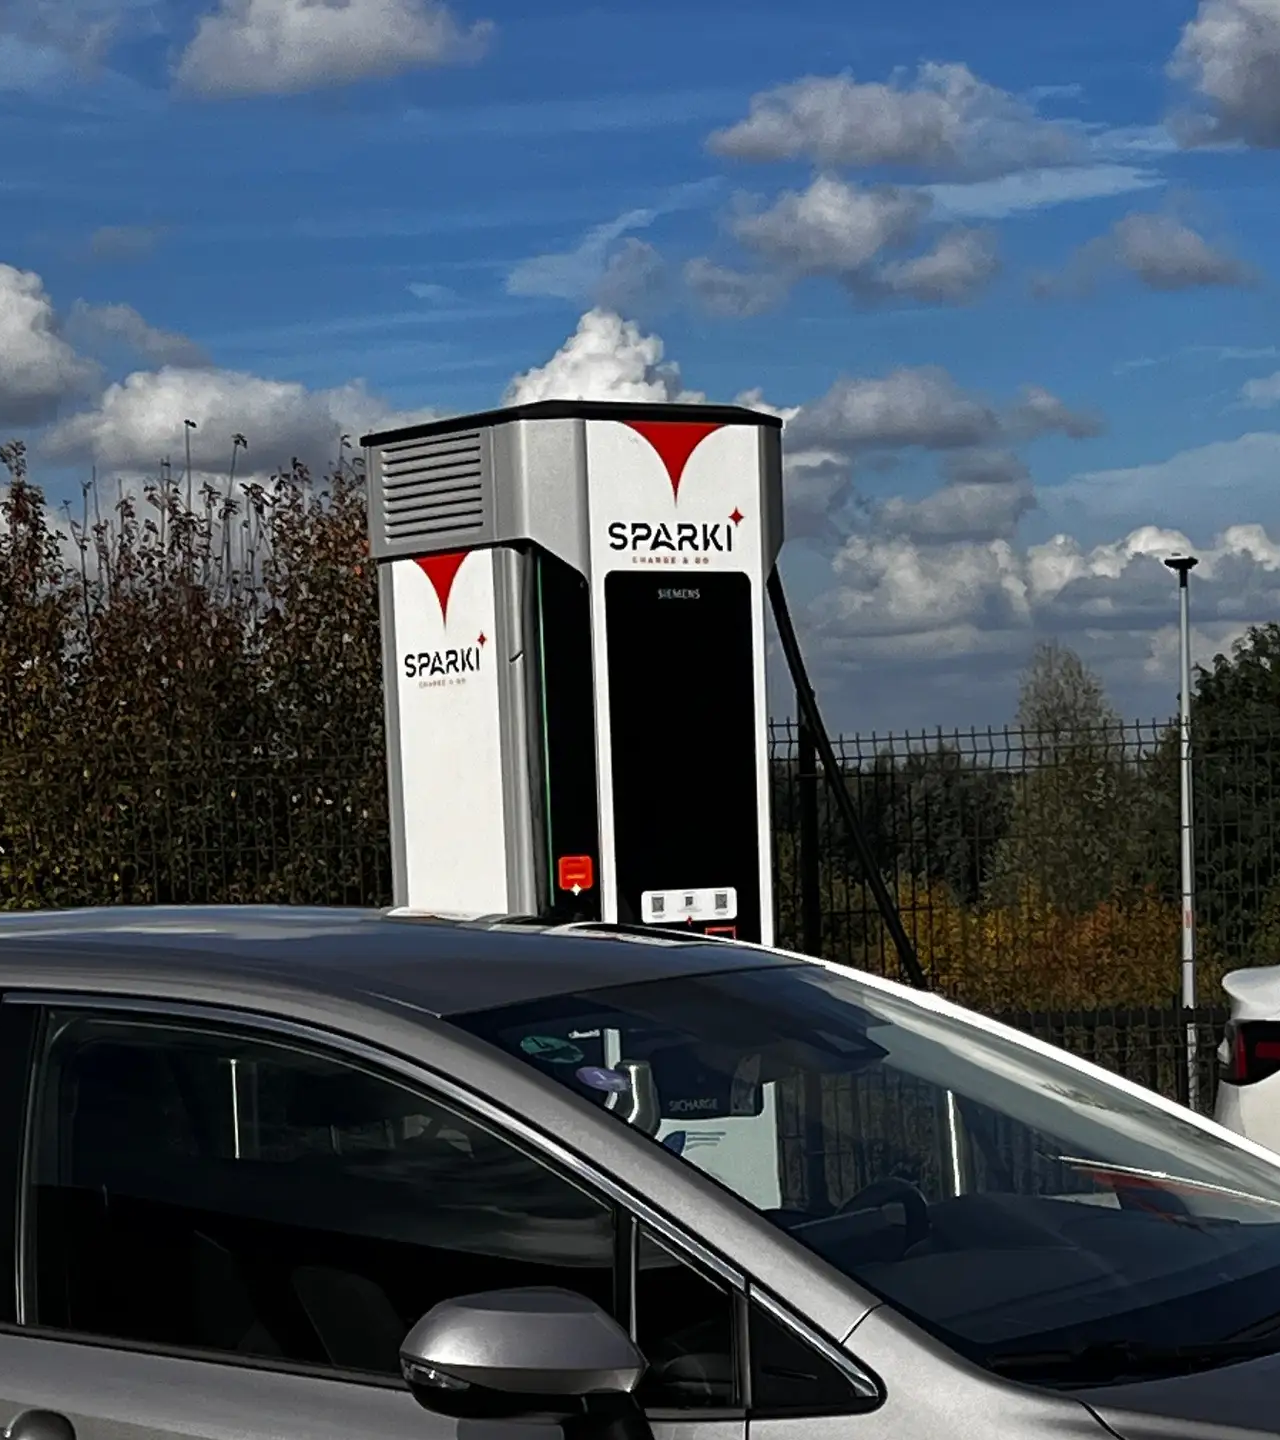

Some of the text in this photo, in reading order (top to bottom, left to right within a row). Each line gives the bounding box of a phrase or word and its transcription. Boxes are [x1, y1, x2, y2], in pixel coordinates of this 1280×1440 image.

[607, 521, 732, 552] SPARKI
[657, 588, 701, 600] SIEMENS
[404, 646, 480, 678] SPARKI
